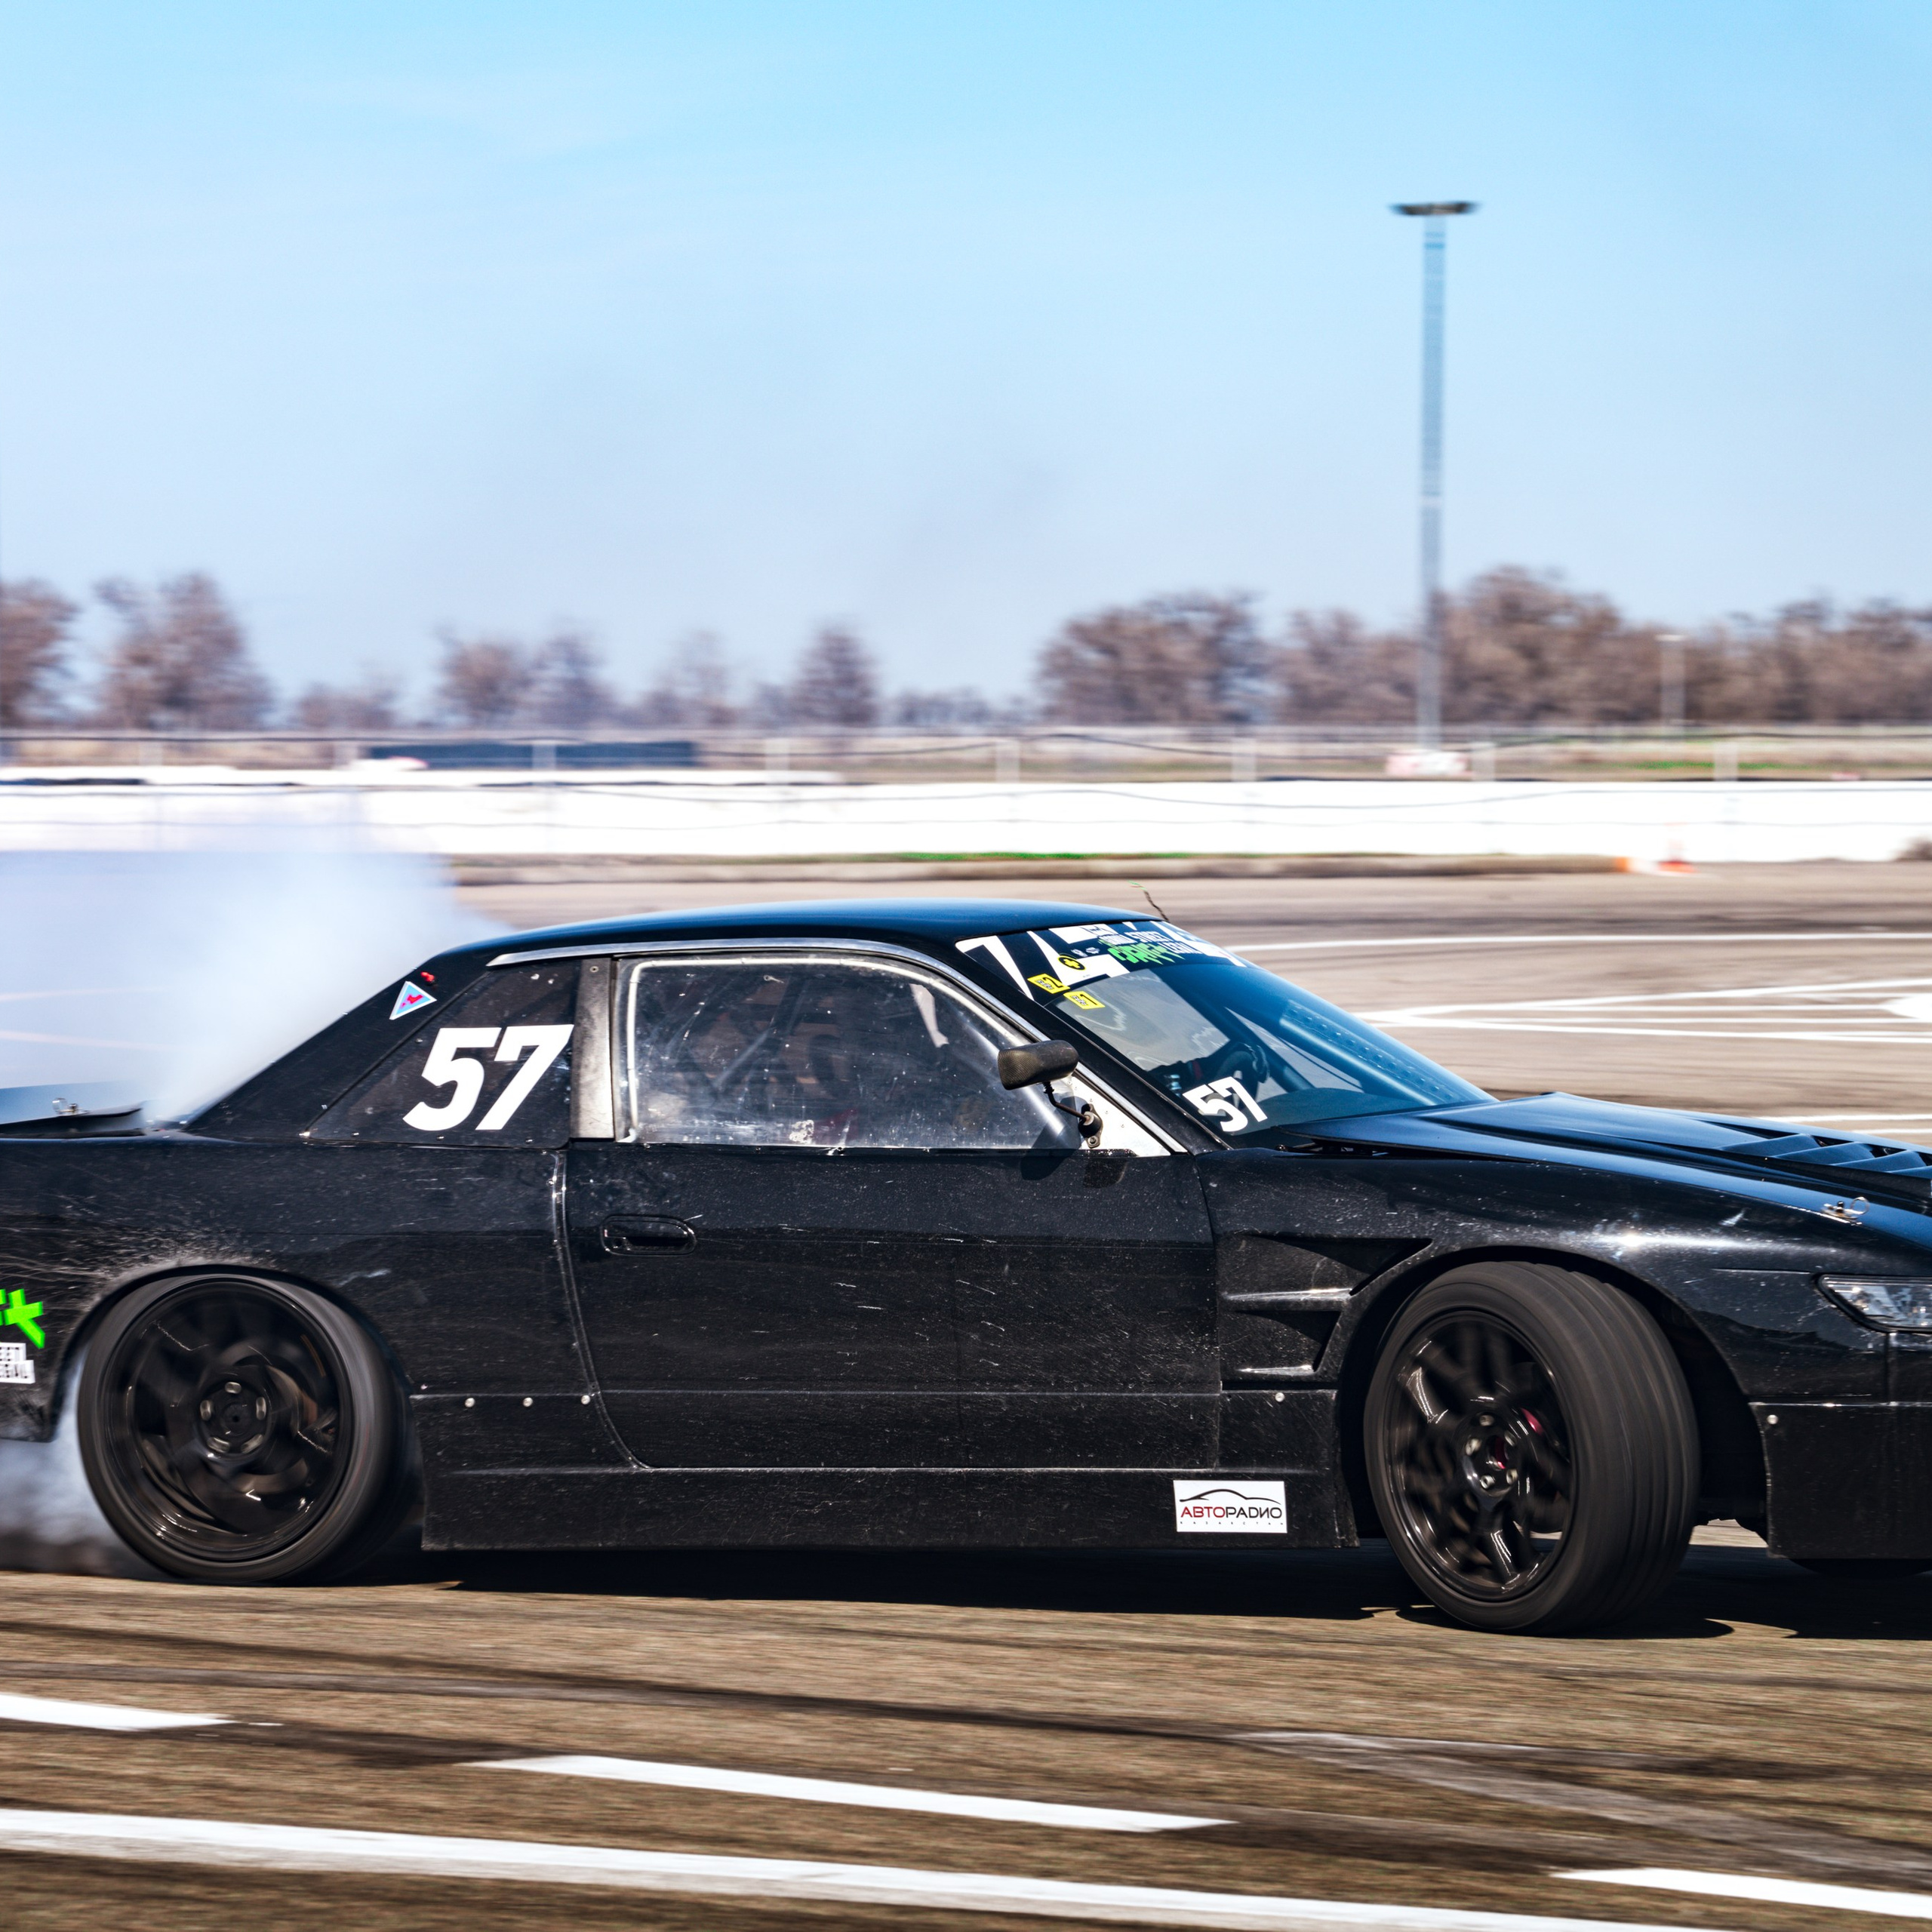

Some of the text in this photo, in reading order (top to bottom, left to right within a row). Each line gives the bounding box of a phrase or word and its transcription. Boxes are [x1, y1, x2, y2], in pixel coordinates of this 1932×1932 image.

[1042, 977, 1064, 989] 2
[1079, 993, 1097, 1005] 1
[402, 1024, 574, 1131] 57
[1182, 1076, 1268, 1132] 57
